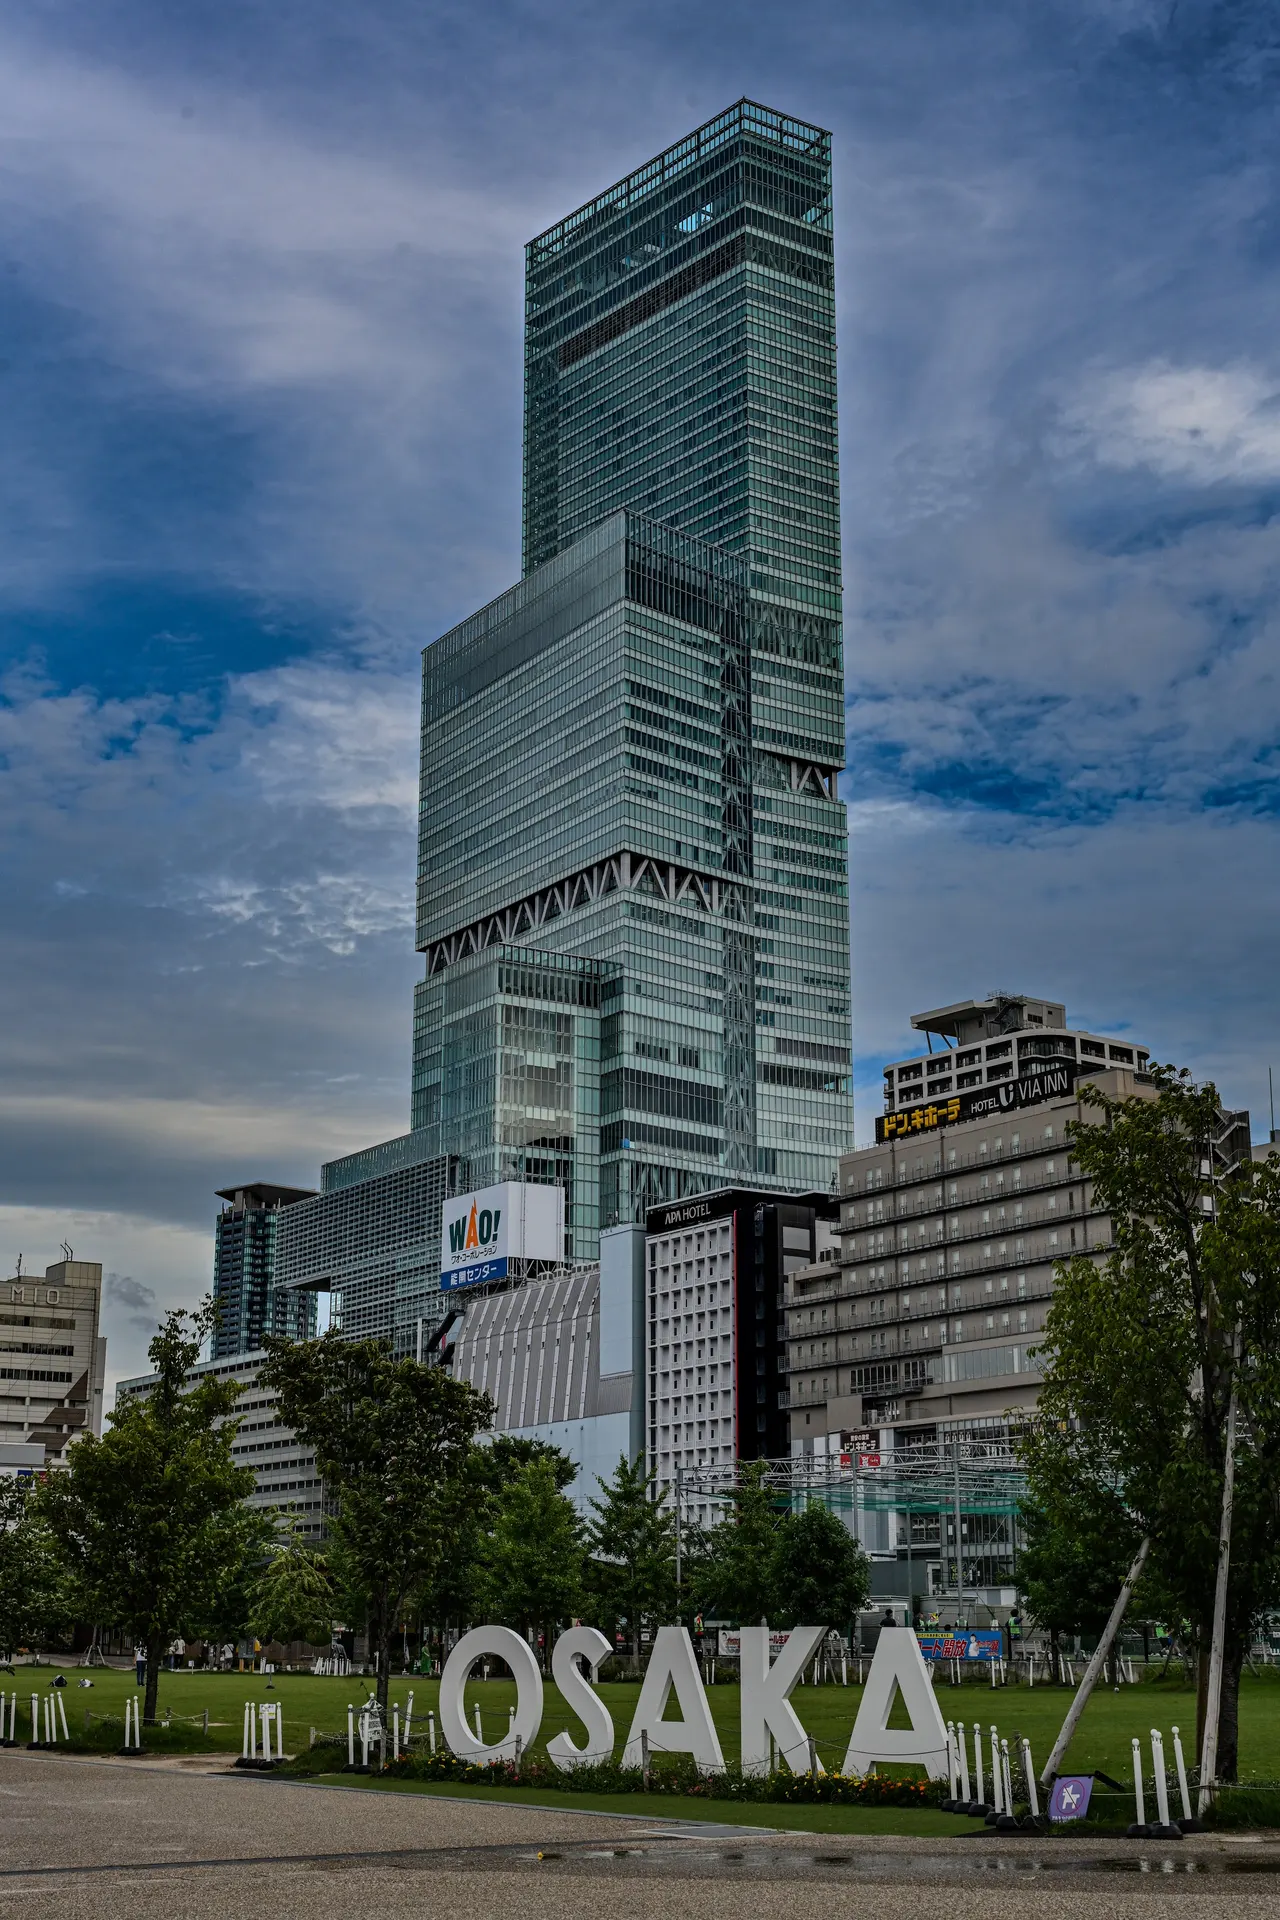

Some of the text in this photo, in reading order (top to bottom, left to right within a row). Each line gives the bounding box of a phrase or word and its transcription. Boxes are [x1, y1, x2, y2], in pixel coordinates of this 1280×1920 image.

[970, 1097, 1000, 1114] HOTEL
[1018, 1078, 1041, 1101] VIA
[1044, 1070, 1068, 1095] INN
[449, 1197, 501, 1253] WAO!
[664, 1203, 711, 1225] APA HOTEL
[11, 1286, 60, 1305] MIO
[438, 1625, 949, 1781] OSAKA
